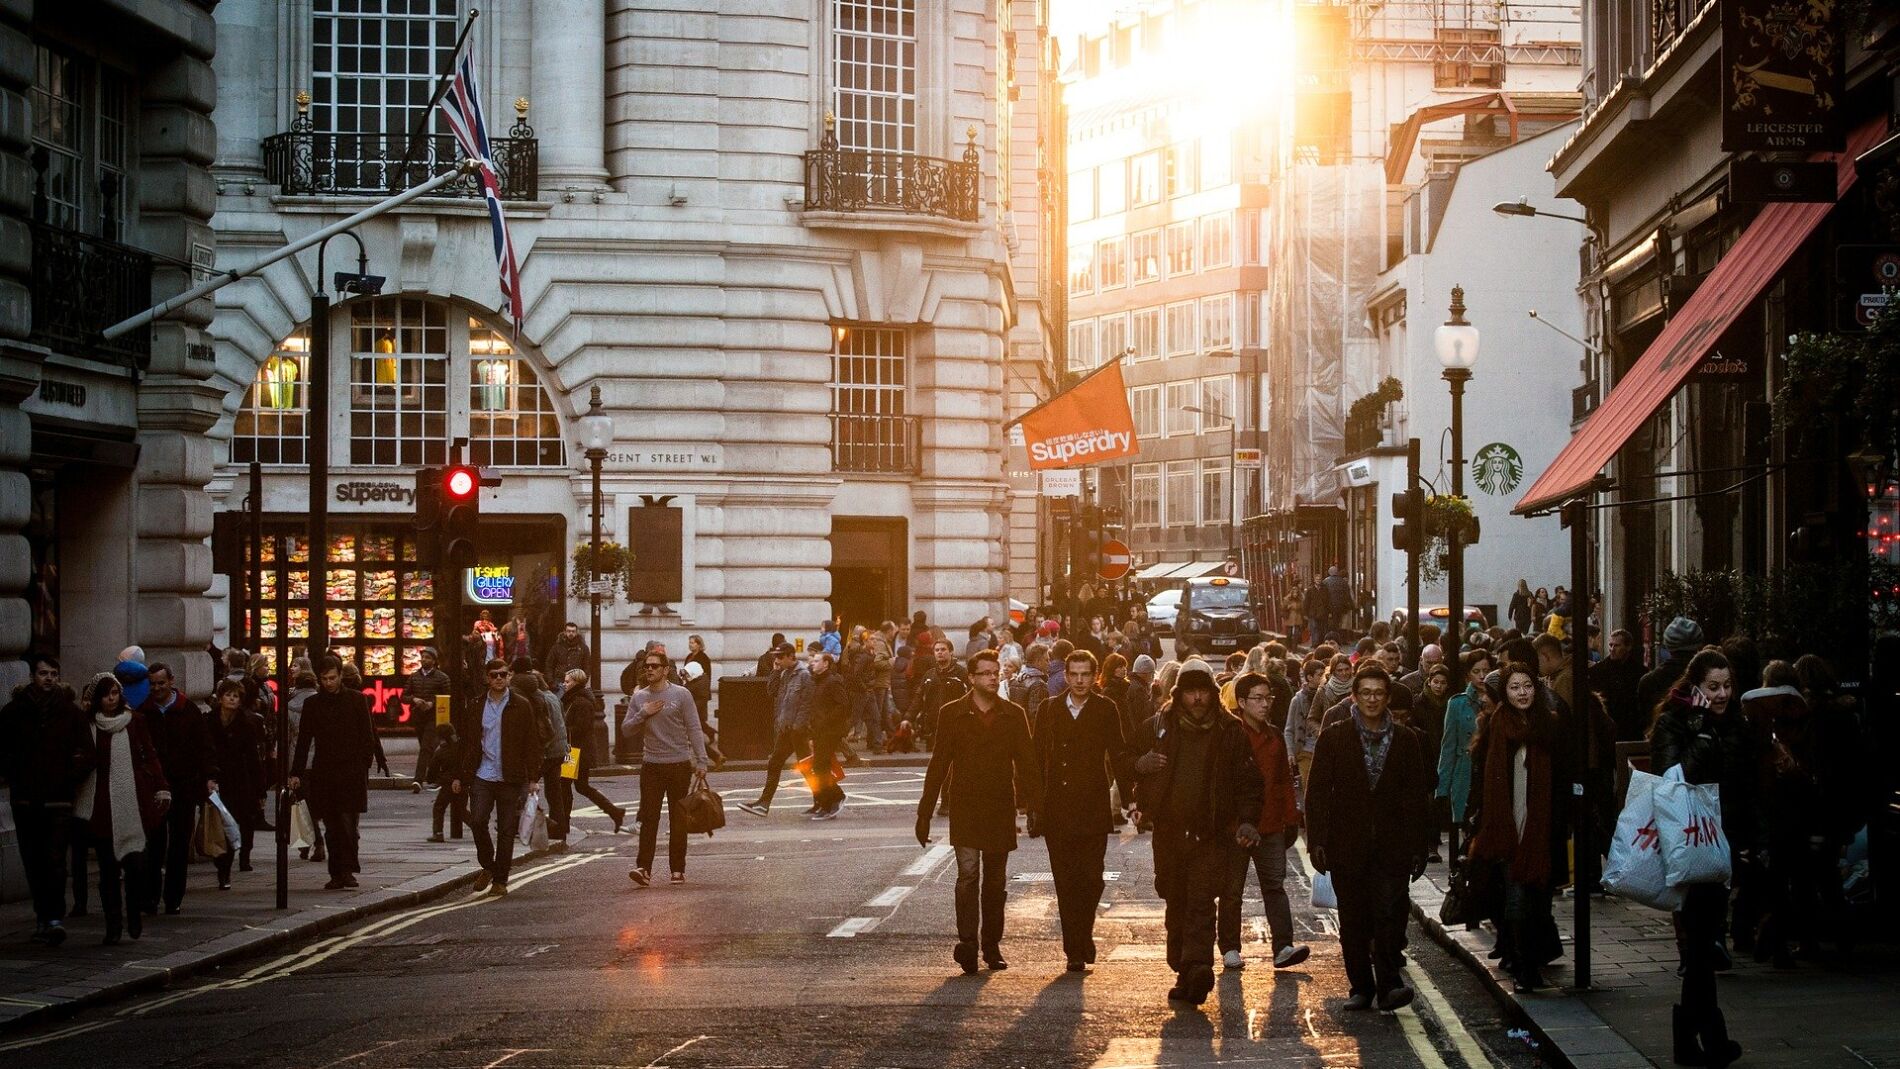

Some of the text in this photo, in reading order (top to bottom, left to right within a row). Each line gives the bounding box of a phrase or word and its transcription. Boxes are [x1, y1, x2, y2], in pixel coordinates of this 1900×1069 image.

[1747, 123, 1824, 133] LEICESTER
[1767, 137, 1806, 146] ARMS
[1863, 296, 1886, 304] PROUD
[1031, 430, 1131, 462] Superdry
[651, 454, 693, 463] STREET
[336, 483, 416, 506] Superdry
[475, 566, 510, 578] T-SHIRT
[476, 576, 515, 588] GALLERY
[1683, 814, 1720, 850] H&M
